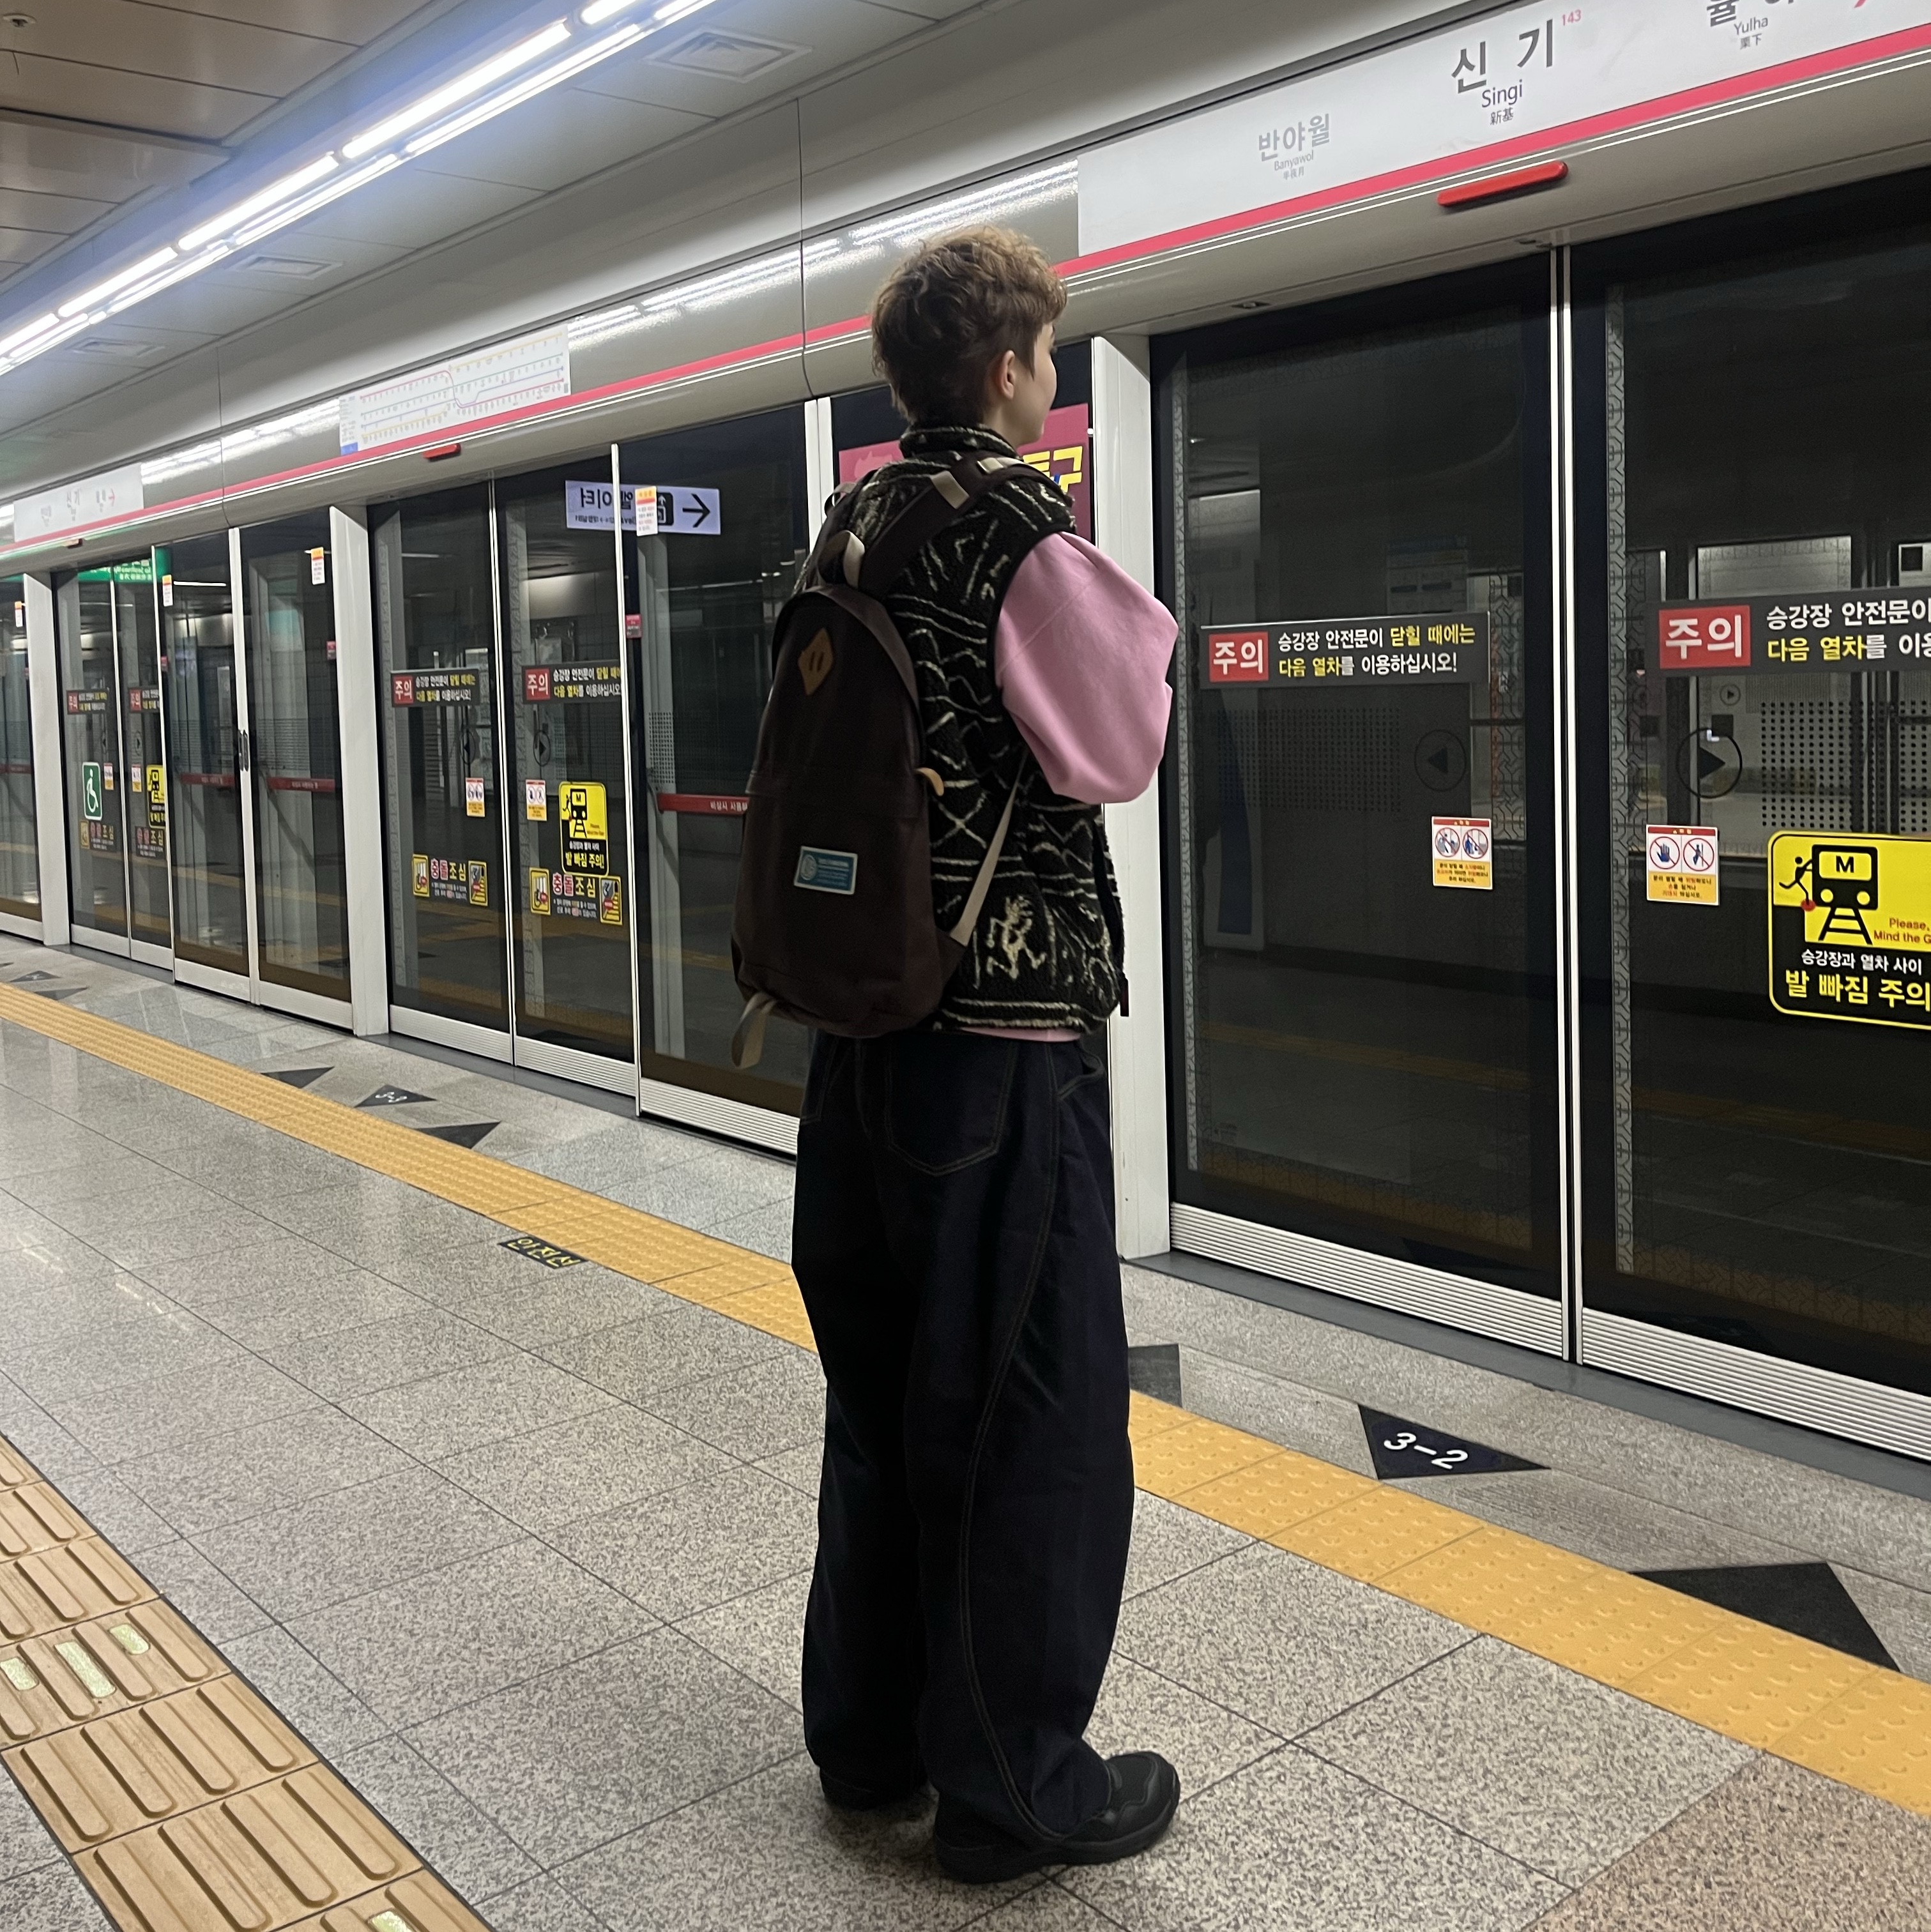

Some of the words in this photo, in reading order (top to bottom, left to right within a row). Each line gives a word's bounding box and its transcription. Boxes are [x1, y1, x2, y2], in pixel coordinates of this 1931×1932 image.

[1562, 9, 1582, 26] 143
[1734, 17, 1769, 36] Yulha
[1482, 79, 1523, 108] Singi
[1490, 107, 1514, 125] 新基
[1258, 113, 1330, 162] 반야월
[1274, 149, 1314, 171] Banyawol
[1767, 604, 1832, 631] 승강장
[1842, 598, 1931, 626] 안전문이
[1278, 631, 1320, 652] 승강장
[1325, 628, 1383, 650] 안전문이
[1390, 626, 1421, 647] 닫힐
[1428, 623, 1476, 645] 때에는
[1665, 614, 1743, 660] 주의
[1767, 637, 1810, 663] 다음
[1820, 634, 1887, 661] 열차를
[1213, 639, 1264, 675] 주의
[1279, 658, 1306, 677] 다음
[1312, 656, 1355, 676] 열차를
[1361, 652, 1458, 675] 이용하십시오!
[395, 680, 413, 700] 주의
[527, 673, 549, 696] 주의
[554, 685, 565, 697] 다음
[1836, 855, 1854, 874] M
[1874, 930, 1900, 941] Mind
[1903, 931, 1921, 943] the
[1801, 948, 1855, 969] 승강장과
[1861, 954, 1889, 972] 열차
[1893, 957, 1922, 976] 사이
[1785, 970, 1810, 998] 발
[1819, 974, 1868, 1005] 빠짐
[1879, 978, 1930, 1012] 주의
[1384, 1432, 1469, 1470] 3-2
